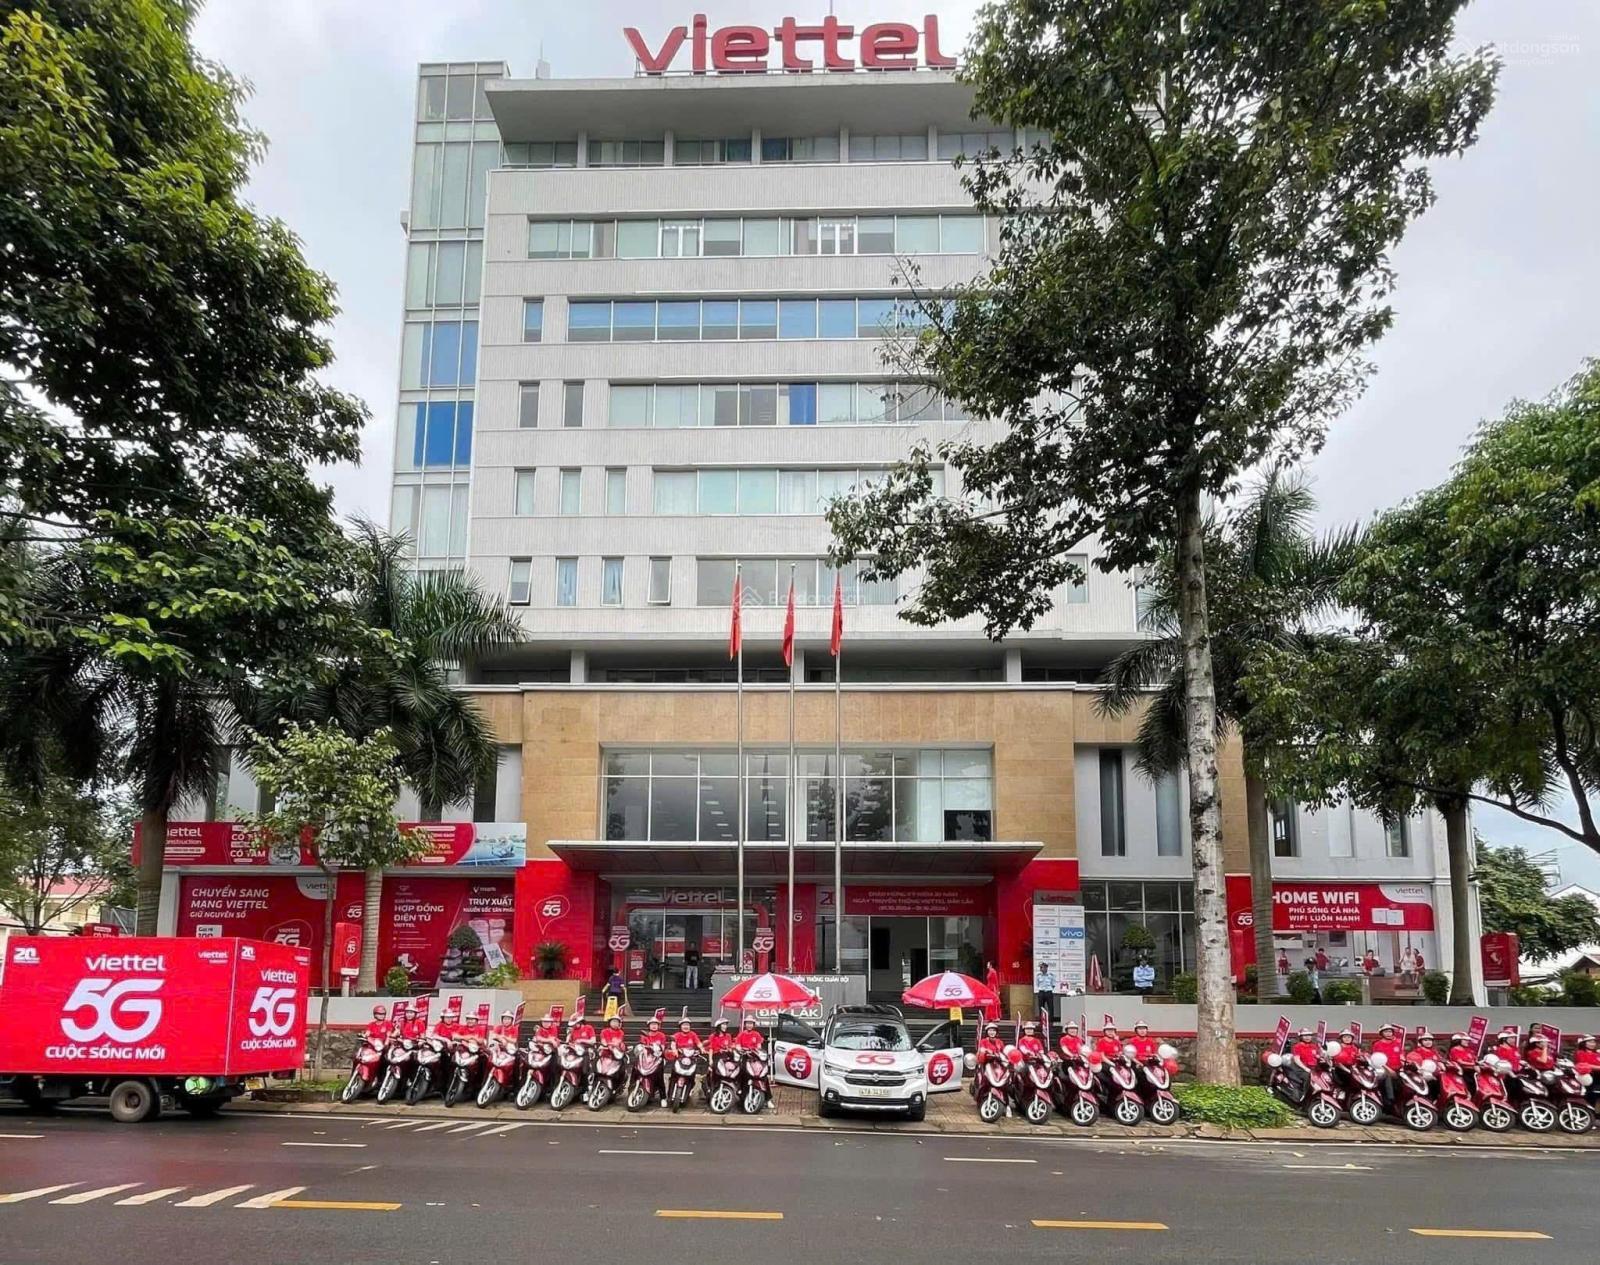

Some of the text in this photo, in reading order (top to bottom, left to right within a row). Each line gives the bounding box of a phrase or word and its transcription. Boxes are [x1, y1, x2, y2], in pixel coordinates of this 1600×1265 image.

[623, 13, 957, 75] viettel
[167, 827, 202, 837] iettel
[192, 884, 270, 898] CHUYỂN SANG
[1272, 891, 1359, 904] HOME WIFI
[226, 900, 269, 909] VIETTEL
[491, 896, 513, 905] XUẤT
[1307, 905, 1329, 914] SÓNG
[1061, 930, 1083, 938] vivo
[85, 953, 166, 971] viettel
[260, 969, 297, 983] viettel
[944, 988, 962, 997] 5G
[60, 978, 165, 1043] 5G
[248, 986, 297, 1037] 5G
[45, 1042, 166, 1060] CUỘC SỐNG MỚI
